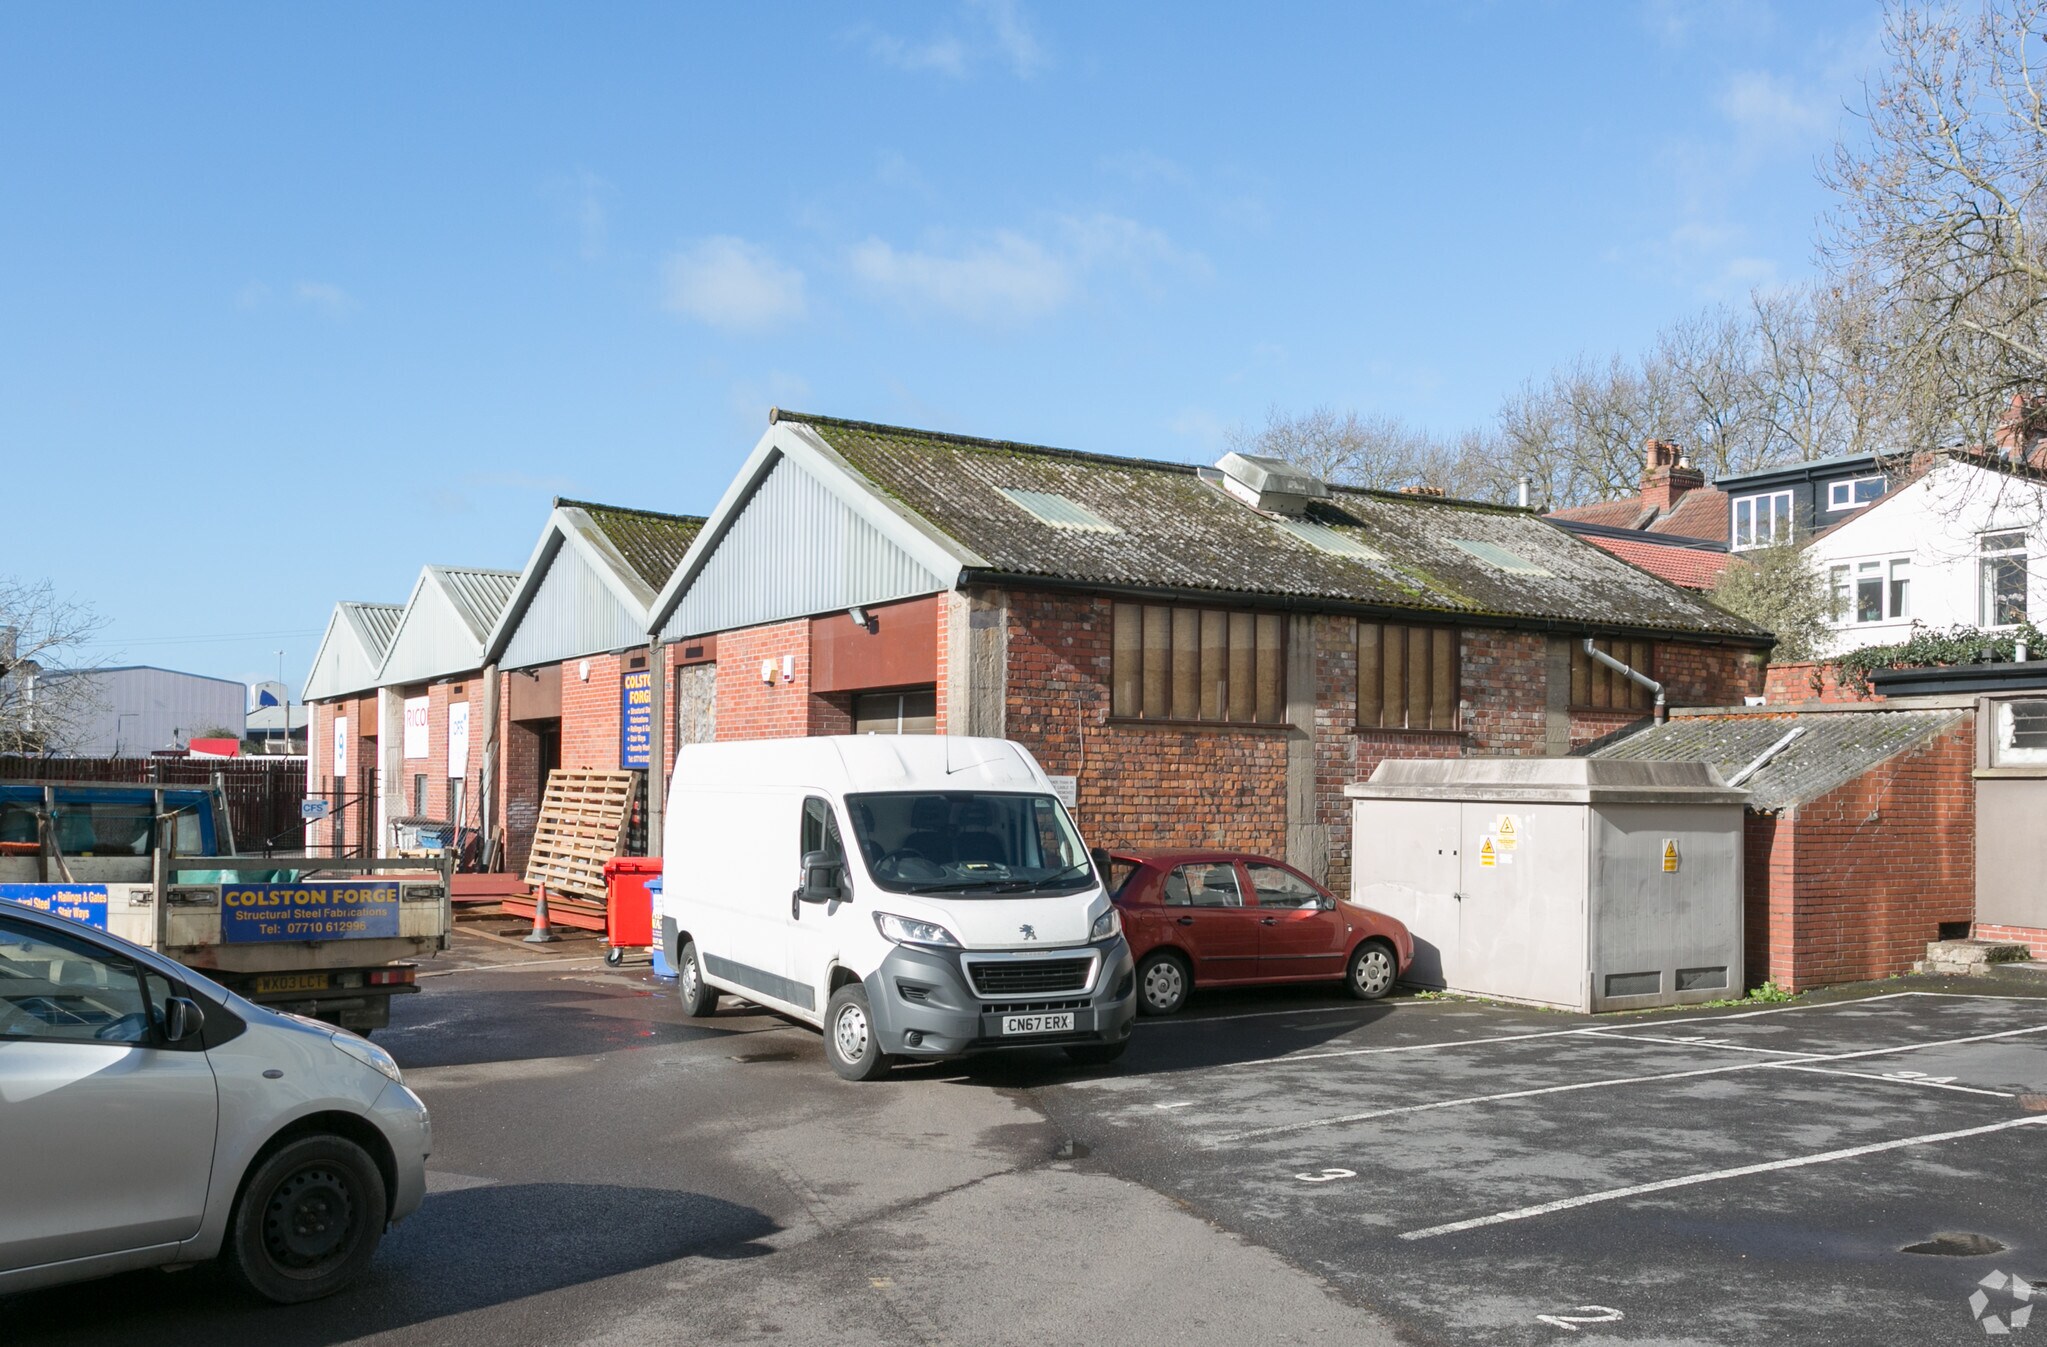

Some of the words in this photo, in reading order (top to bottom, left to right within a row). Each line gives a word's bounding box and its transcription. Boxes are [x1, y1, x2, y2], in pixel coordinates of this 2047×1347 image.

[338, 733, 344, 759] 9
[303, 803, 324, 812] CFS
[33, 897, 51, 910] Steel
[57, 891, 82, 905] Railings
[82, 891, 88, 903] &
[89, 891, 107, 903] Gates
[225, 890, 327, 906] COLSTON
[332, 889, 398, 904] FORGE
[57, 907, 72, 918] Stair
[72, 907, 90, 921] Ways
[236, 907, 291, 921] Structural
[294, 907, 321, 919] Steel
[324, 906, 388, 918] Fabrications
[259, 924, 281, 935] Tel:
[287, 922, 323, 933] 07710
[299, 975, 324, 988] LCT
[1009, 1017, 1042, 1032] CN67
[1045, 1015, 1068, 1030] ERX
[1295, 1168, 1357, 1182] 3
[1536, 1304, 1625, 1331] 2
